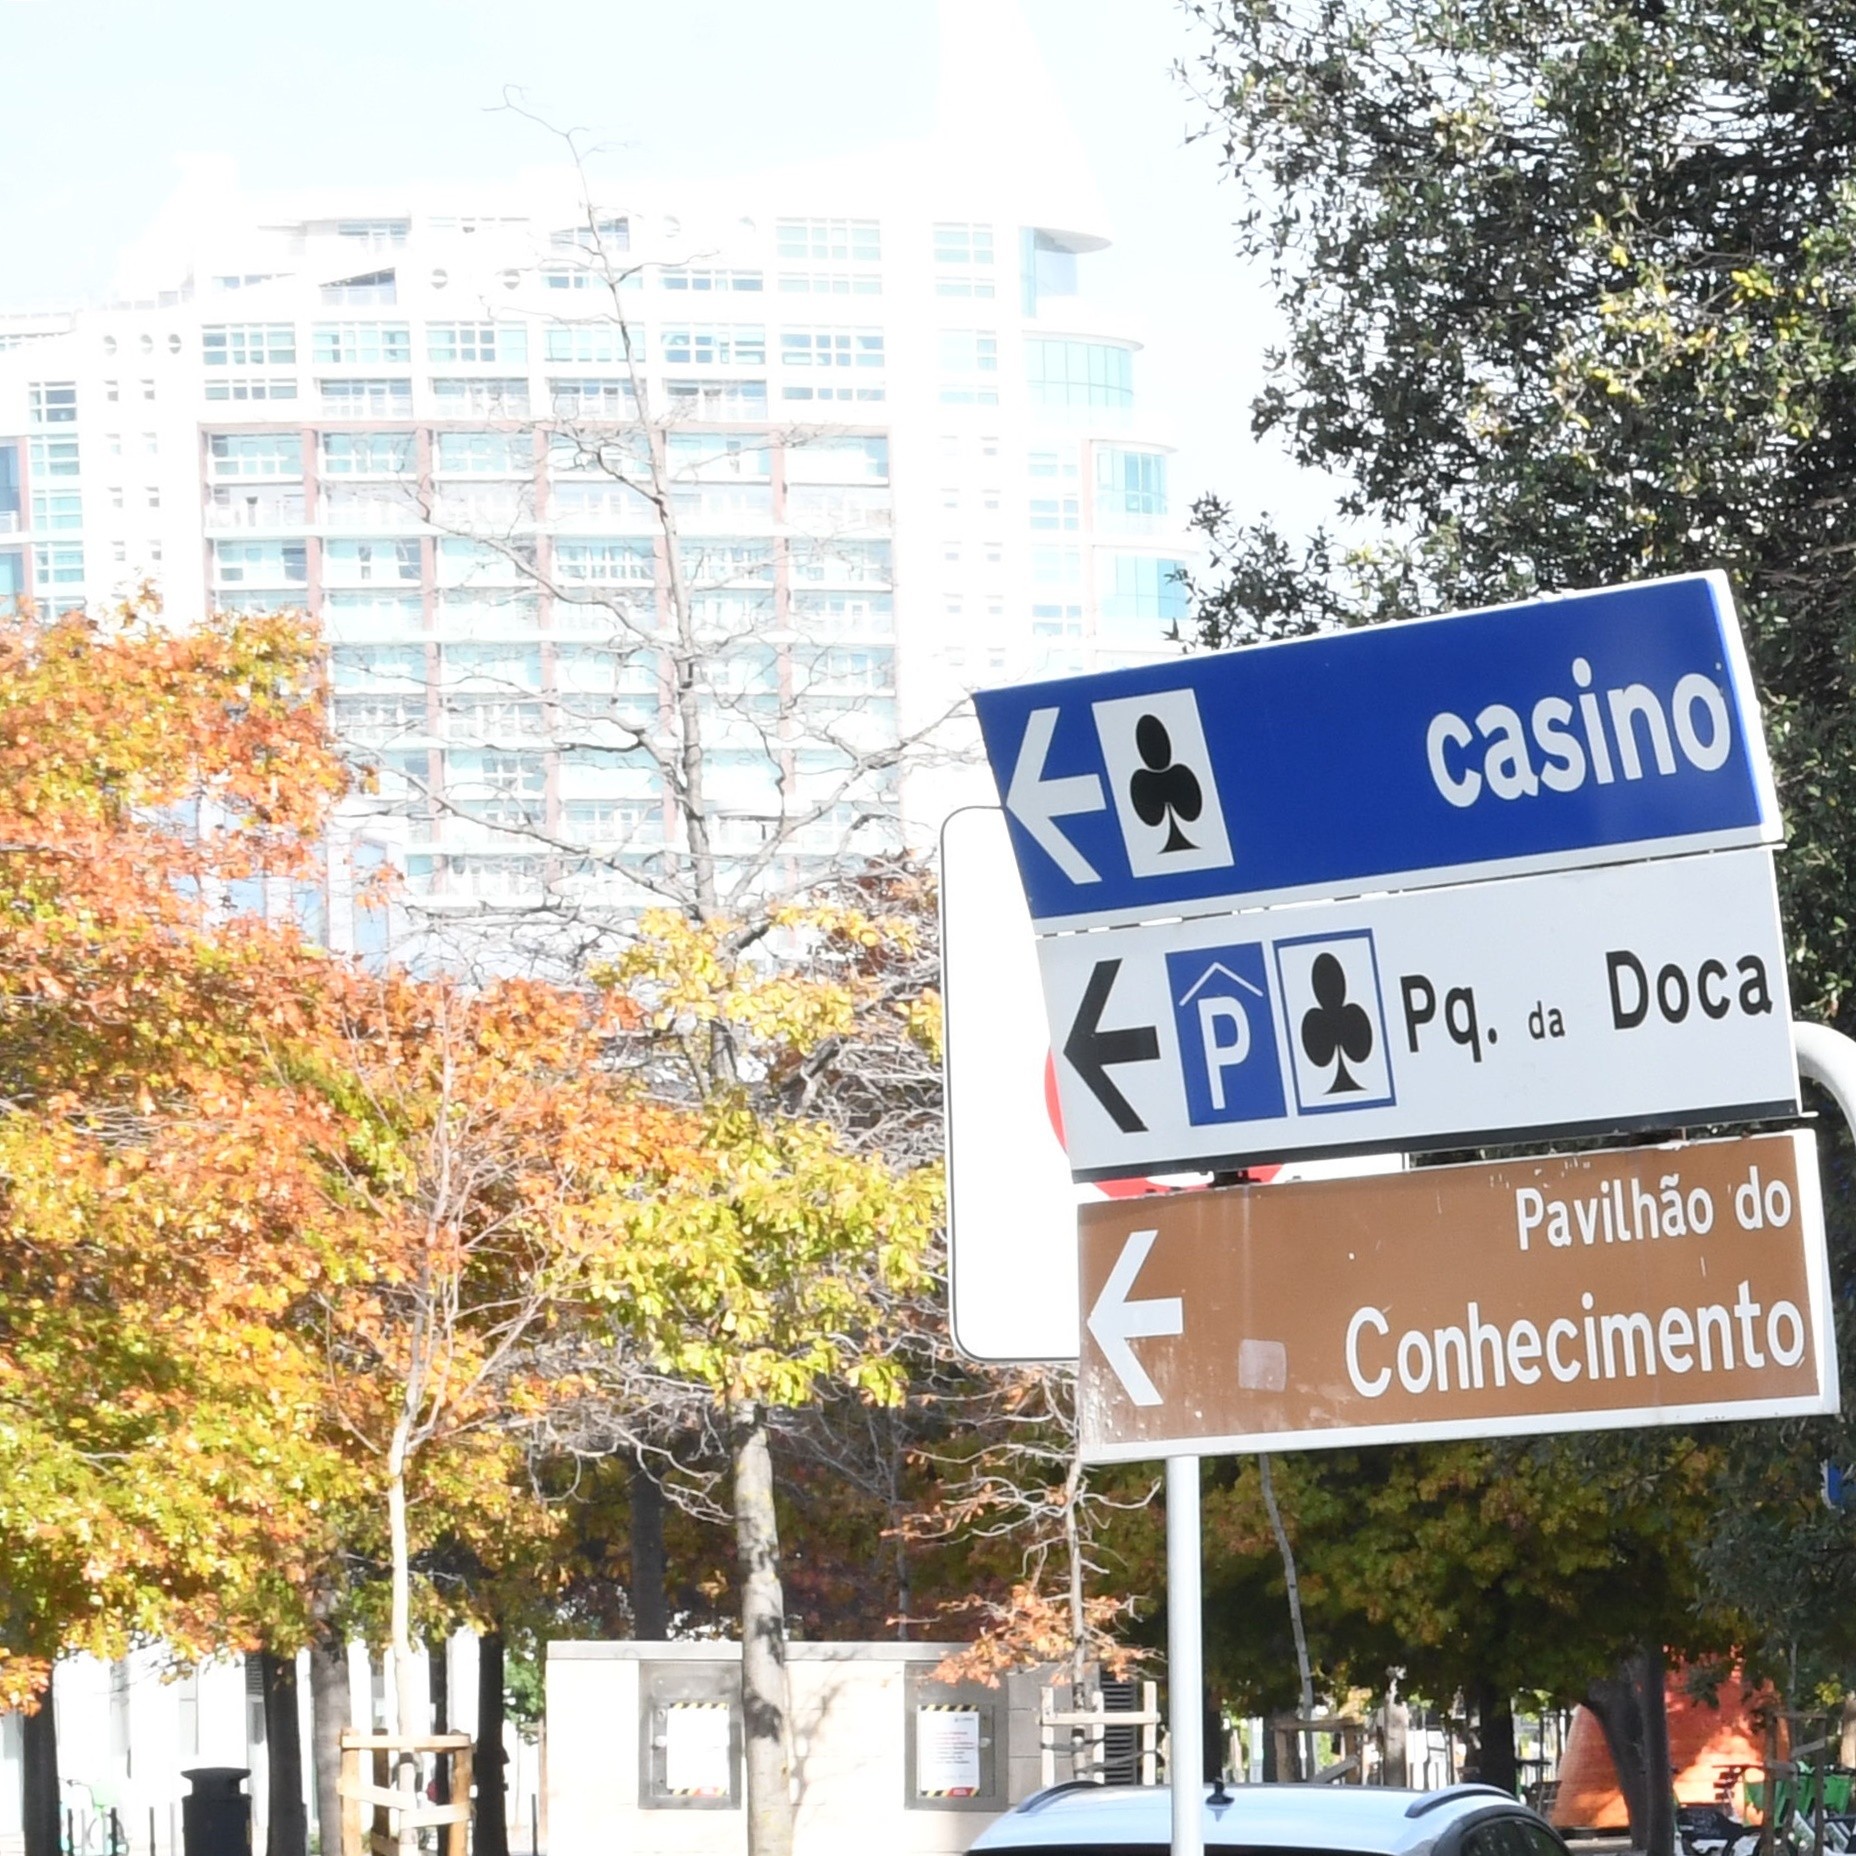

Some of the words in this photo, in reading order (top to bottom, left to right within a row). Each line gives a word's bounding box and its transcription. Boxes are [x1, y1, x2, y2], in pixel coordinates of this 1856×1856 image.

[1426, 657, 1731, 808] casino
[1401, 974, 1498, 1063] Pq.
[1528, 1000, 1566, 1040] da
[1605, 950, 1773, 1030] Doca
[1516, 1174, 1714, 1250] Pavilhão
[1735, 1165, 1792, 1230] do
[1345, 1281, 1803, 1398] Conhecimento
